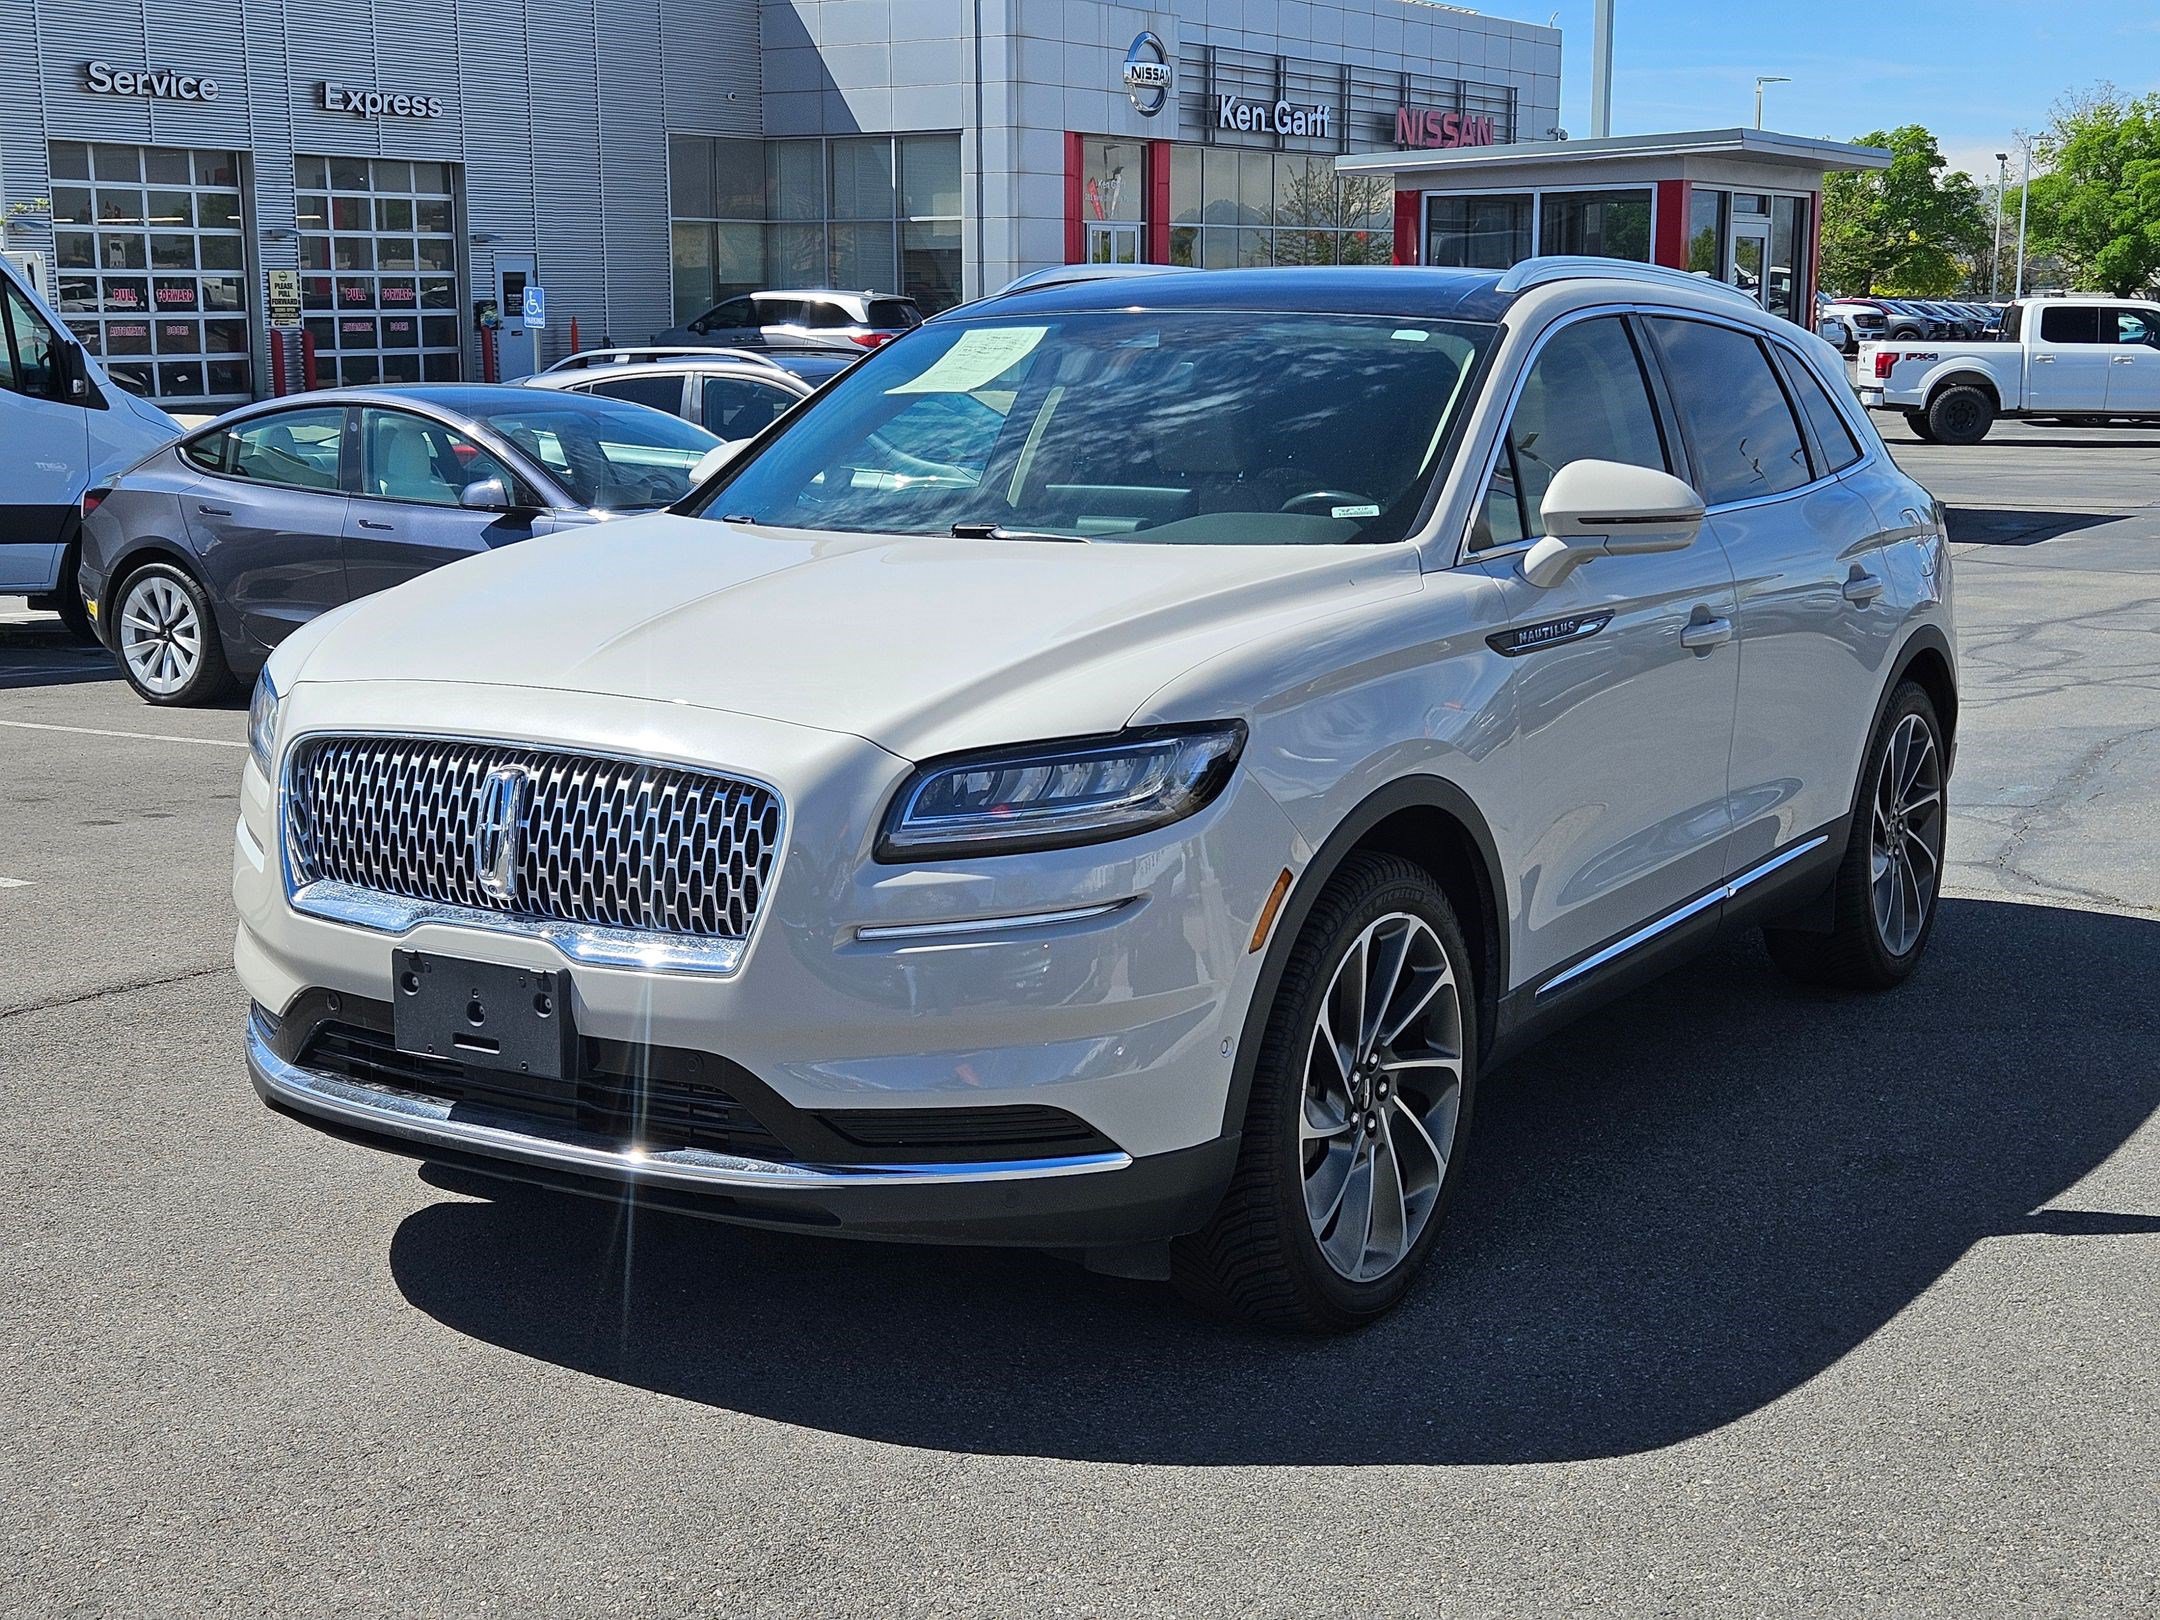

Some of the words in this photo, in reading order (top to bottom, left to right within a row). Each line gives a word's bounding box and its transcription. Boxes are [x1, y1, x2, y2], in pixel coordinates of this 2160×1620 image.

[87, 60, 219, 101] Service
[1131, 65, 1170, 83] NISSAN
[325, 81, 444, 119] Express
[1219, 94, 1267, 132] Ken
[1274, 100, 1330, 138] Garff
[1396, 106, 1494, 148] NISSAN
[113, 289, 138, 302] PULL
[156, 289, 194, 303] FORWARD
[345, 288, 367, 301] PULL
[382, 288, 413, 301] FORWARD
[110, 326, 147, 337] AUTOMATIC
[166, 326, 189, 336] DOORS
[1905, 352, 1939, 362] FX4
[1519, 621, 1575, 644] NAUTILUS
